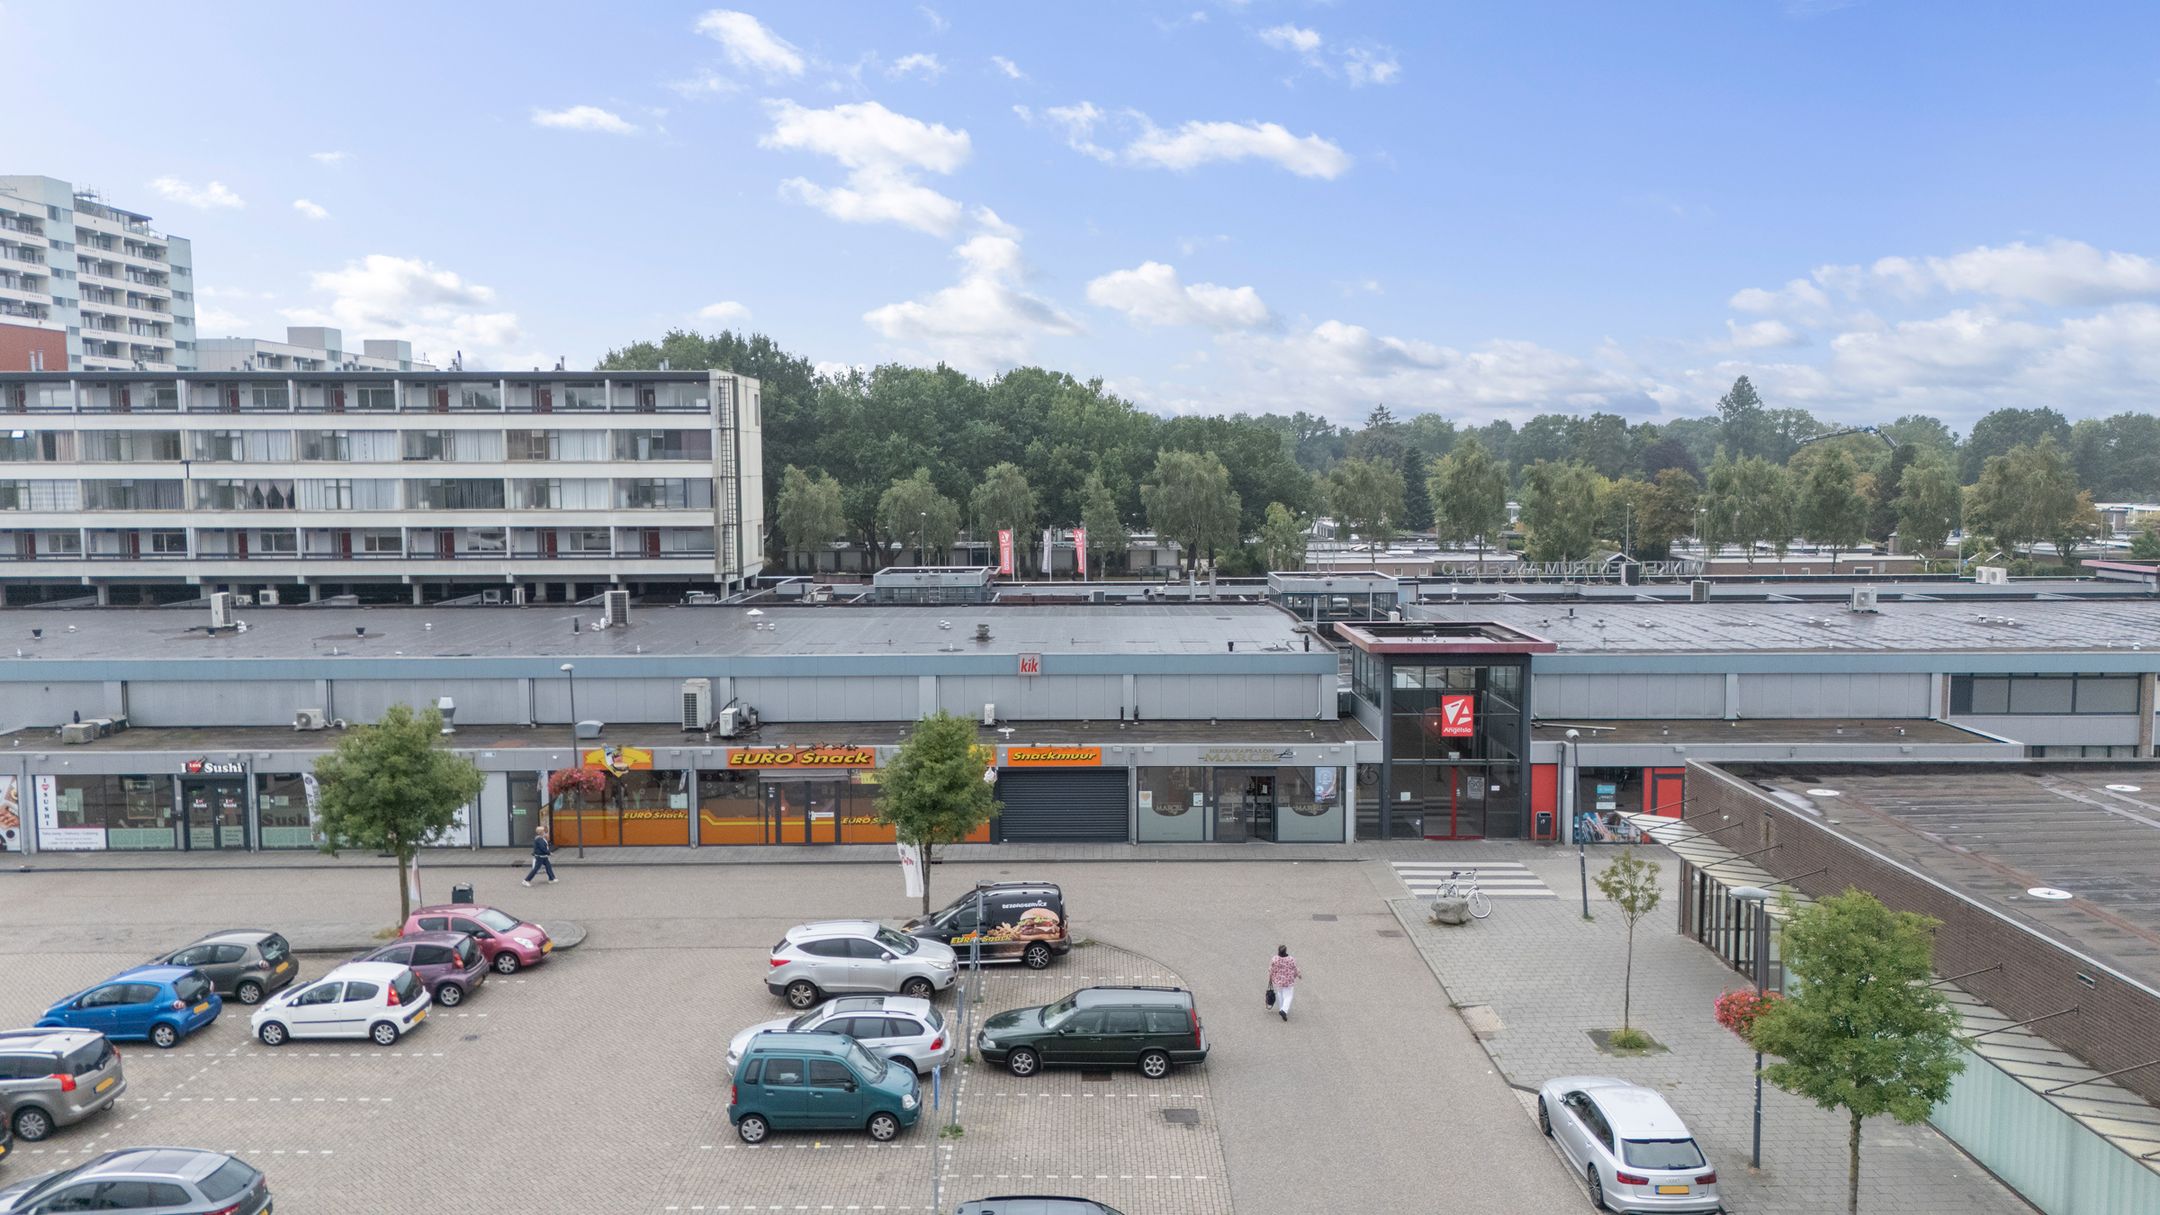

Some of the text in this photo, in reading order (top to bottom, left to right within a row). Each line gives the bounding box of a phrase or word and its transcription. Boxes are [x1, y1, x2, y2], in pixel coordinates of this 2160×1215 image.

[1020, 657, 1038, 673] kik
[1443, 727, 1472, 735] Angelslo
[730, 751, 872, 766] EURO Snack
[1012, 751, 1096, 761] Snackmuur
[204, 762, 243, 773] Sushi
[653, 811, 685, 820] Snack
